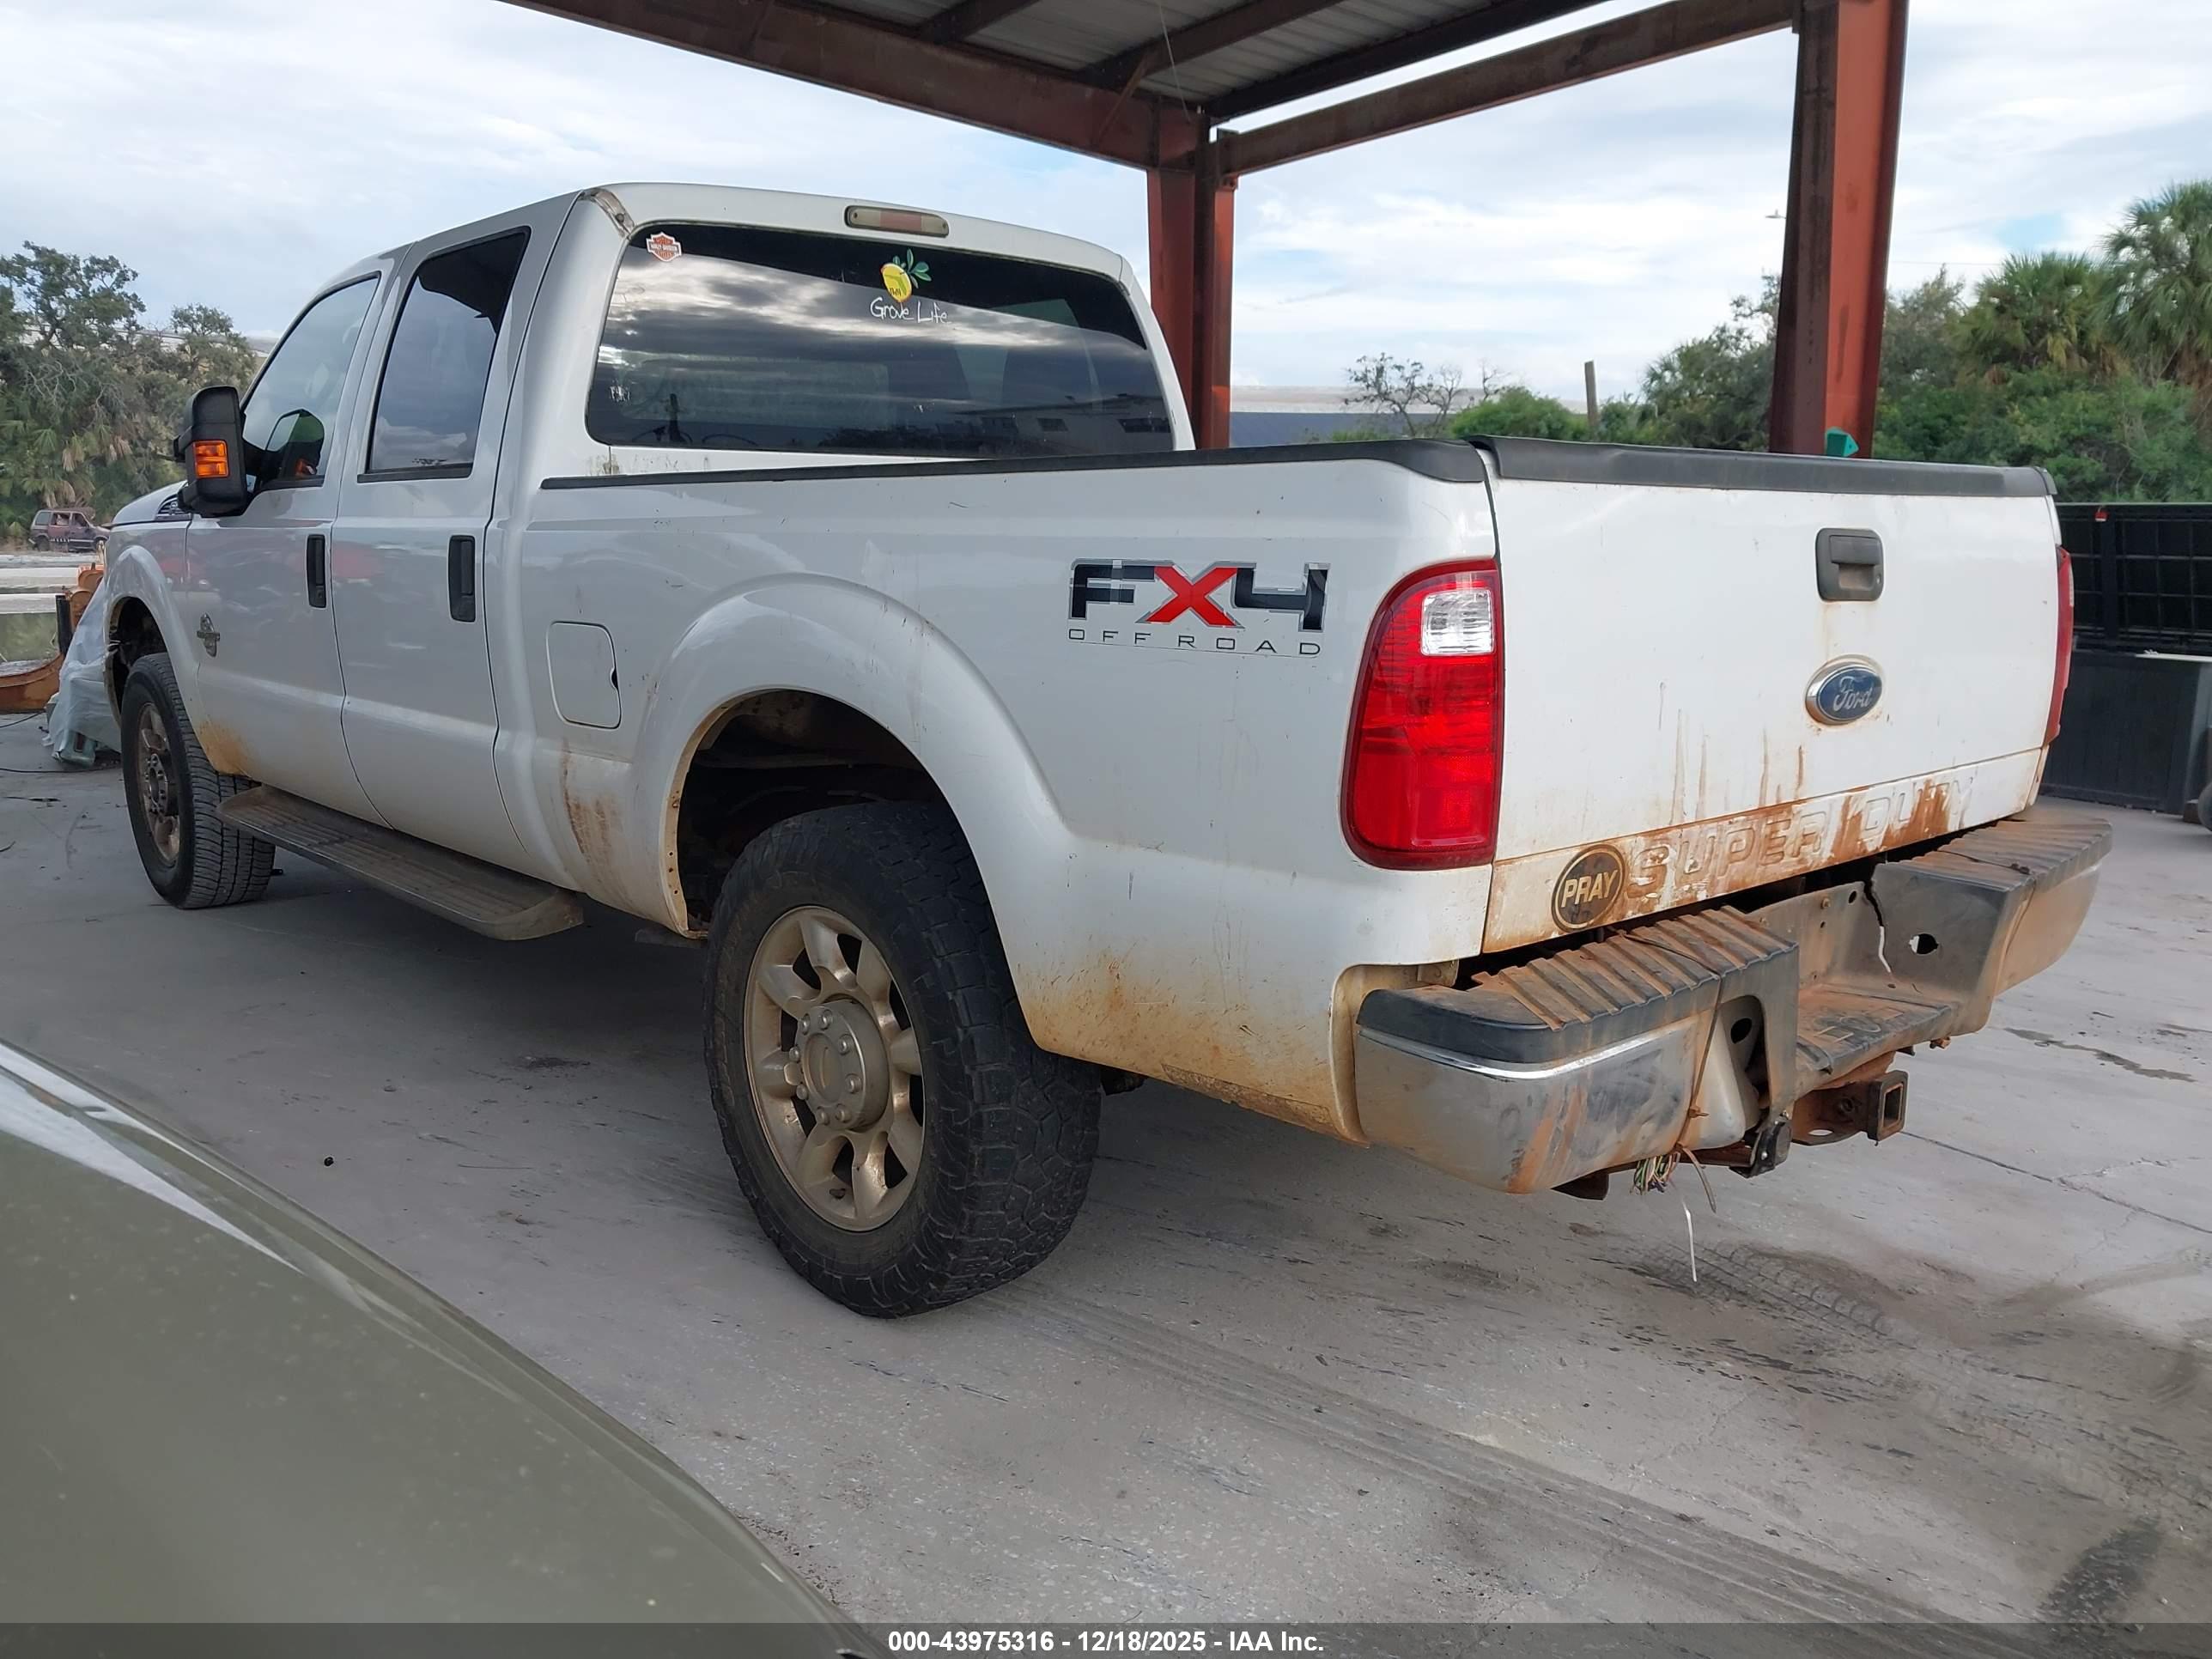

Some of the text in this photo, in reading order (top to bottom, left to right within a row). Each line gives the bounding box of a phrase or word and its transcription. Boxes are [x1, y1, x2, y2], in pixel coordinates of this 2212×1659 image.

[870, 296, 952, 323] Grove Life
[1068, 558, 1330, 632] FX4
[1832, 675, 1874, 712] Ford
[1628, 807, 1831, 896] SUPER
[1561, 870, 1618, 908] PRAY
